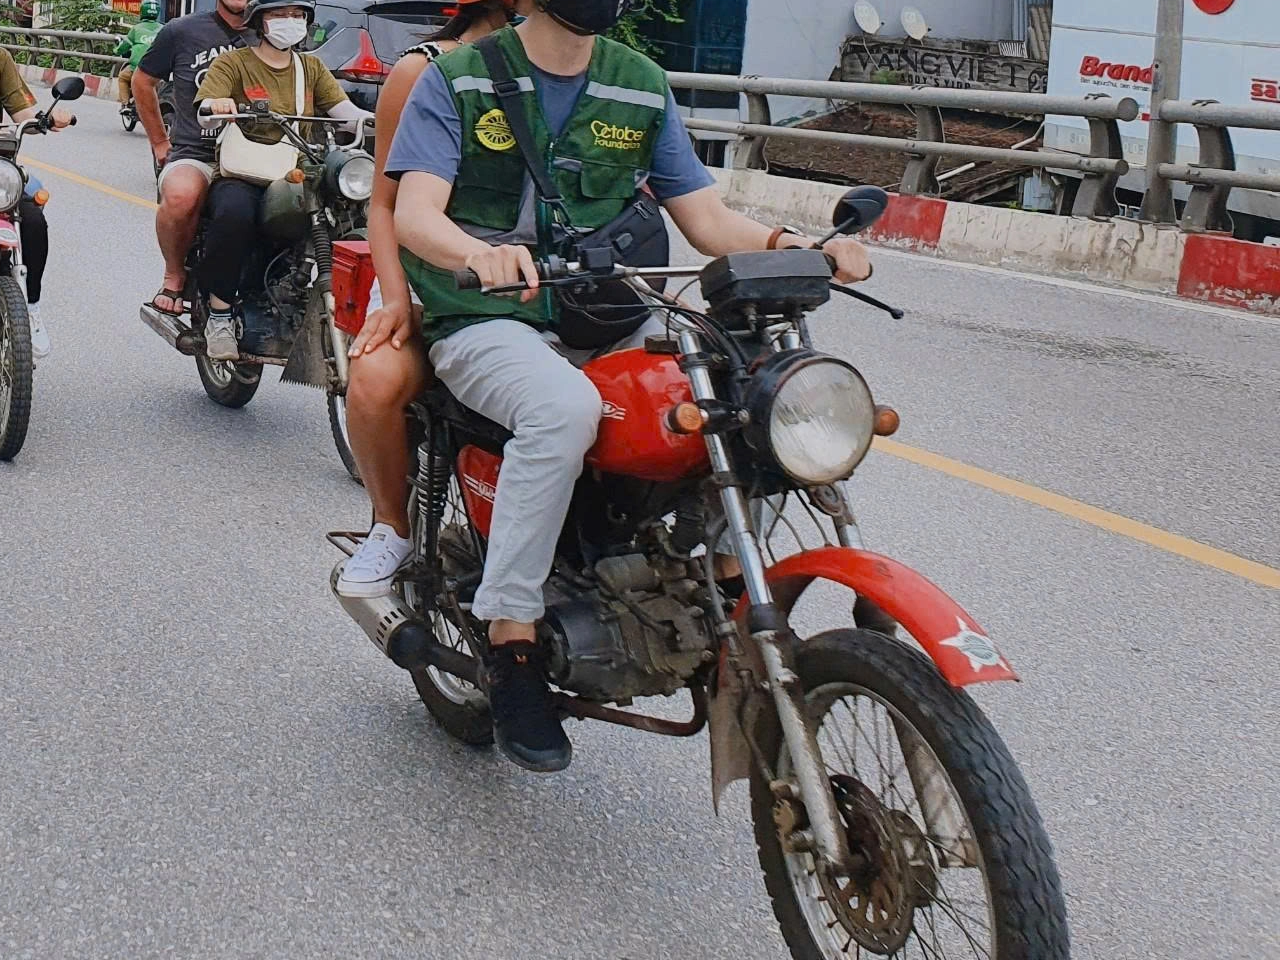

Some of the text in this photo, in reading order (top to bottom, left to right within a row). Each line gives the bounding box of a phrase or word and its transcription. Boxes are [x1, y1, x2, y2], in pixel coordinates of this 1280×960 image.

[190, 44, 238, 69] JEAN
[1079, 55, 1155, 84] Brand
[1250, 82, 1280, 99] sa
